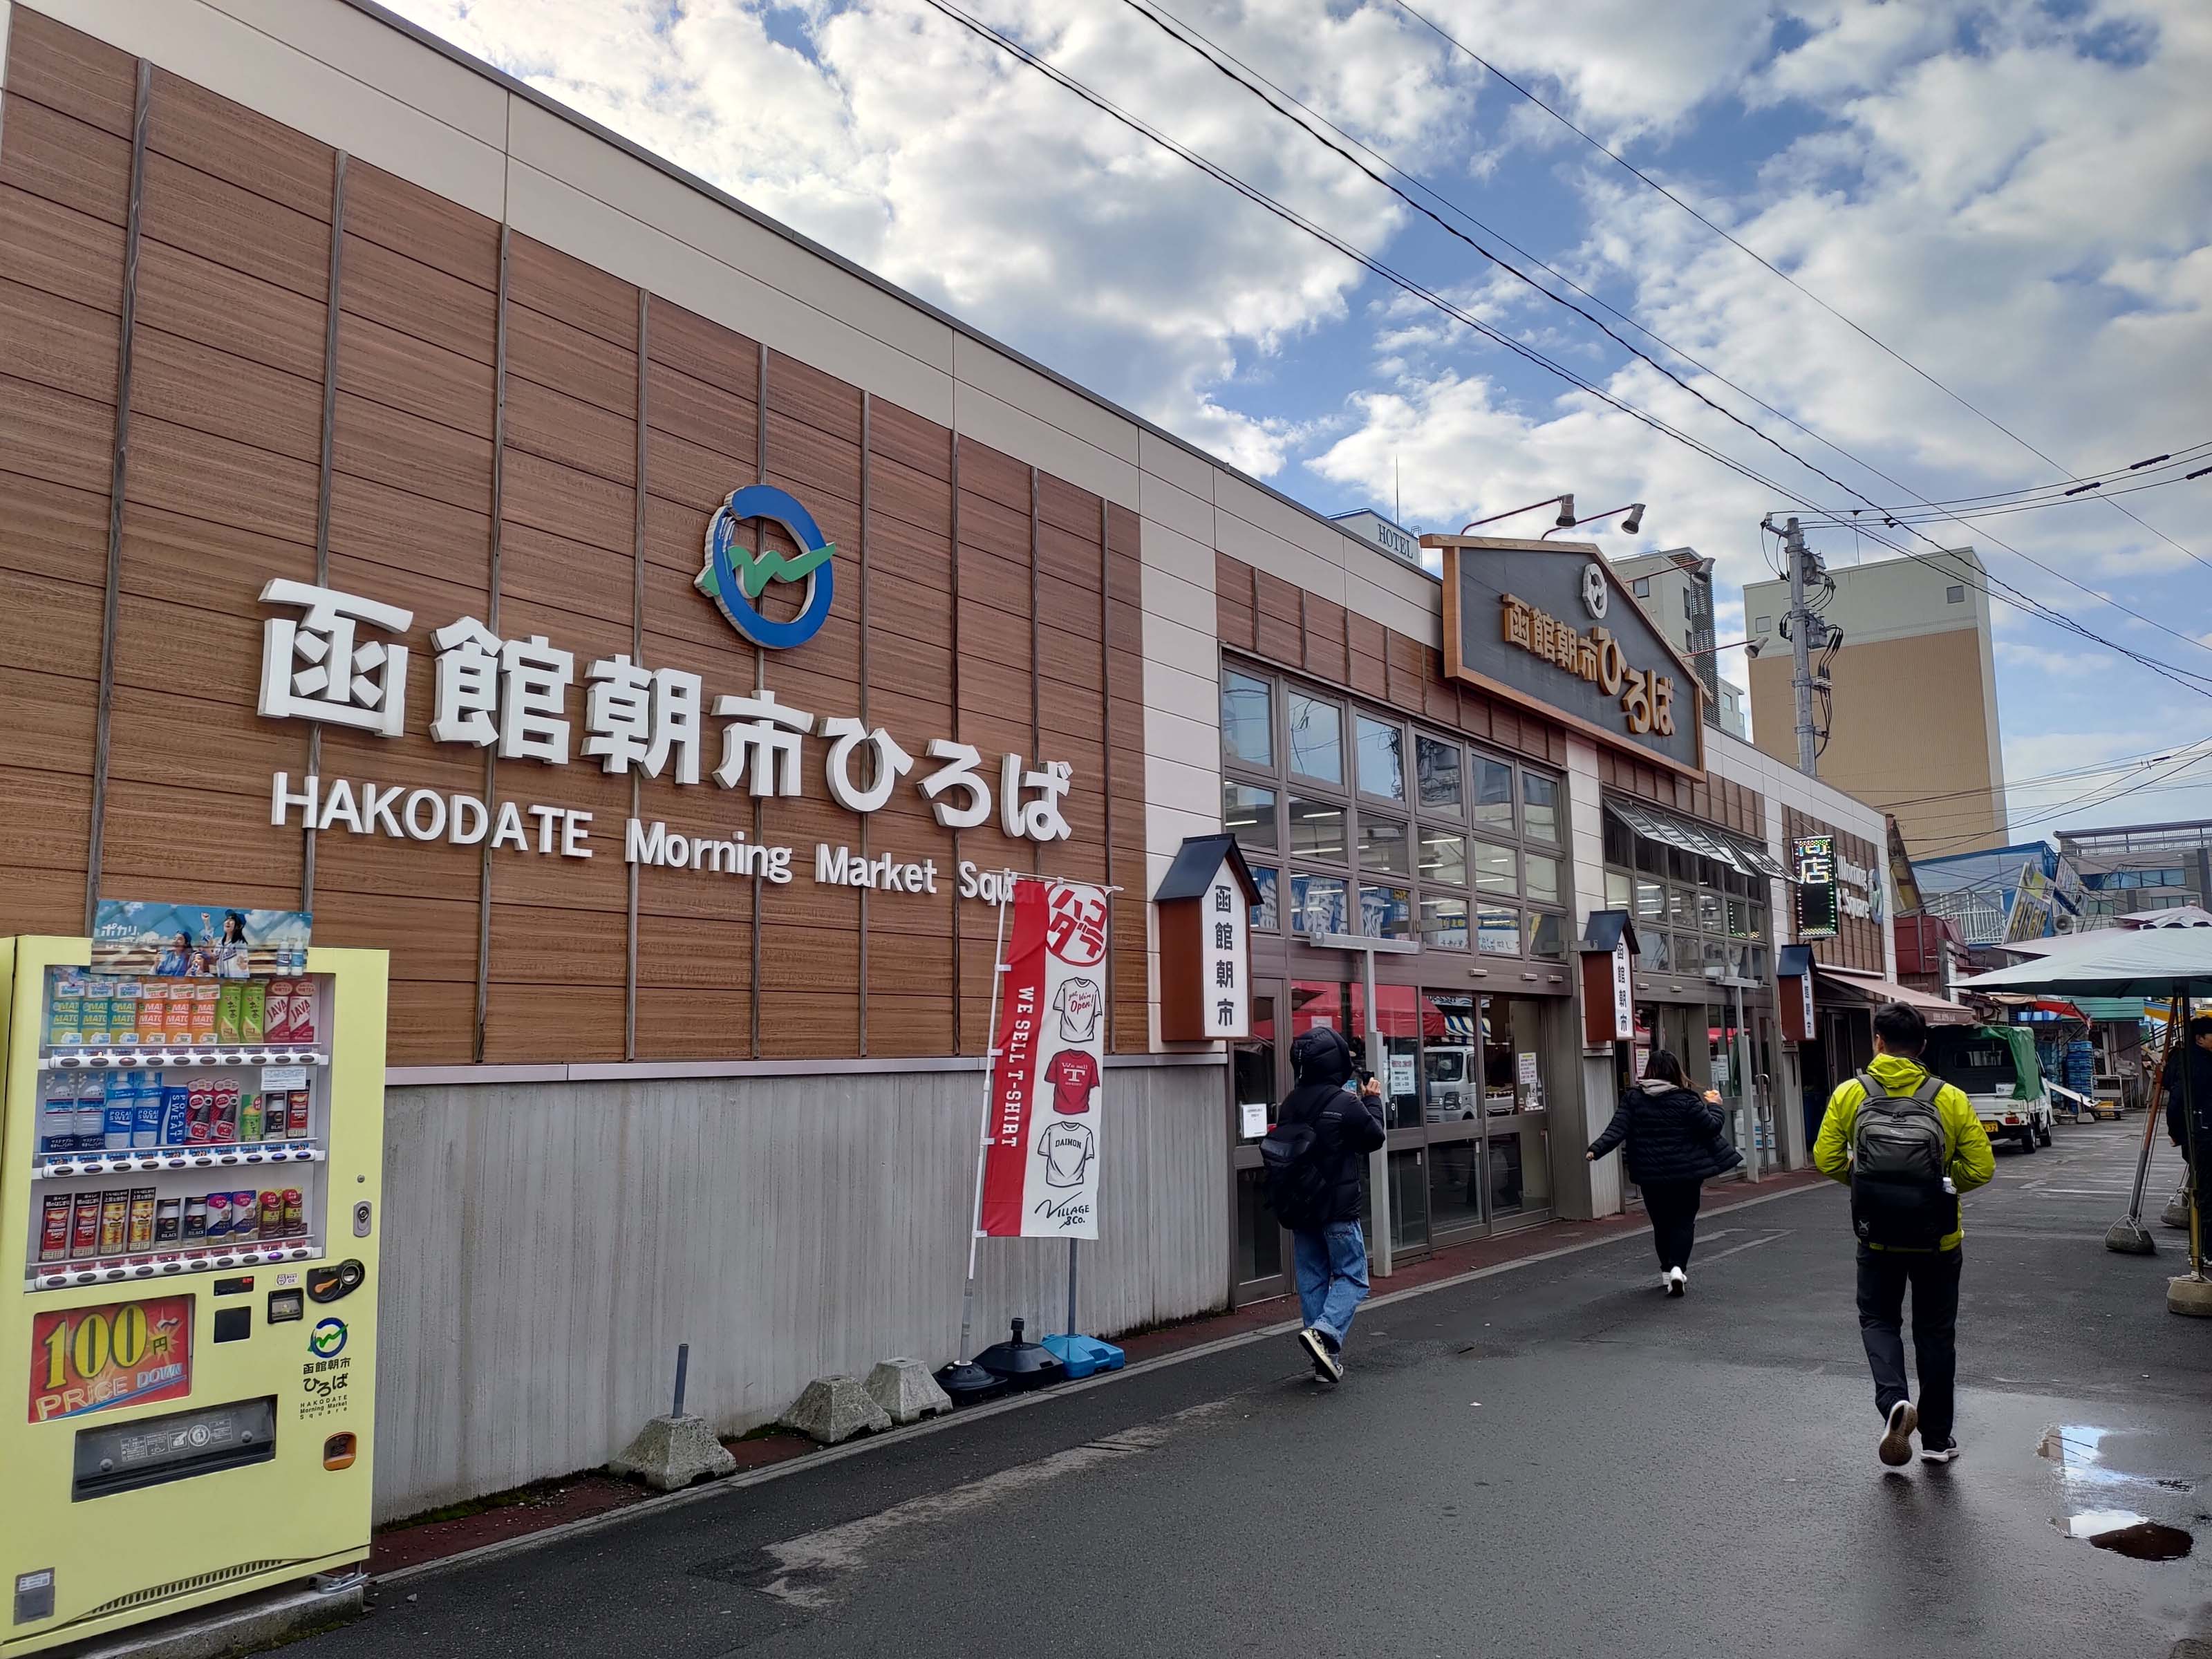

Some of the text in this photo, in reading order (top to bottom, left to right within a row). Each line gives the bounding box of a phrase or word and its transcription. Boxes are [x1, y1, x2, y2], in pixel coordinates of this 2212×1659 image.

[1377, 523, 1414, 559] HOTEL
[1502, 593, 1676, 735] 函館朝市ひろば
[257, 577, 1072, 843] 函館朝市ひろば
[271, 771, 1013, 906] HAKODATE Morning Market Squ
[1215, 885, 1235, 1027] 函館朝市
[267, 999, 287, 1022] JAVA
[291, 999, 310, 1022] JAVA
[1071, 994, 1094, 1015] Open!
[1002, 986, 1034, 1147] WE SELL T-SHIRT
[1063, 1068, 1085, 1082] T
[169, 1094, 180, 1136] SWEAT
[176, 1094, 186, 1142] POCARI
[1055, 1138, 1082, 1150] DAIMON
[1035, 1191, 1089, 1219] VILLAGE
[303, 1357, 351, 1375] 函館朝市
[35, 1362, 184, 1421] PRICE DOWN
[303, 1372, 348, 1398] ひろば
[300, 1395, 348, 1408] HAKODATE
[300, 1400, 348, 1414] Morning Market
[300, 1407, 347, 1420] Square
